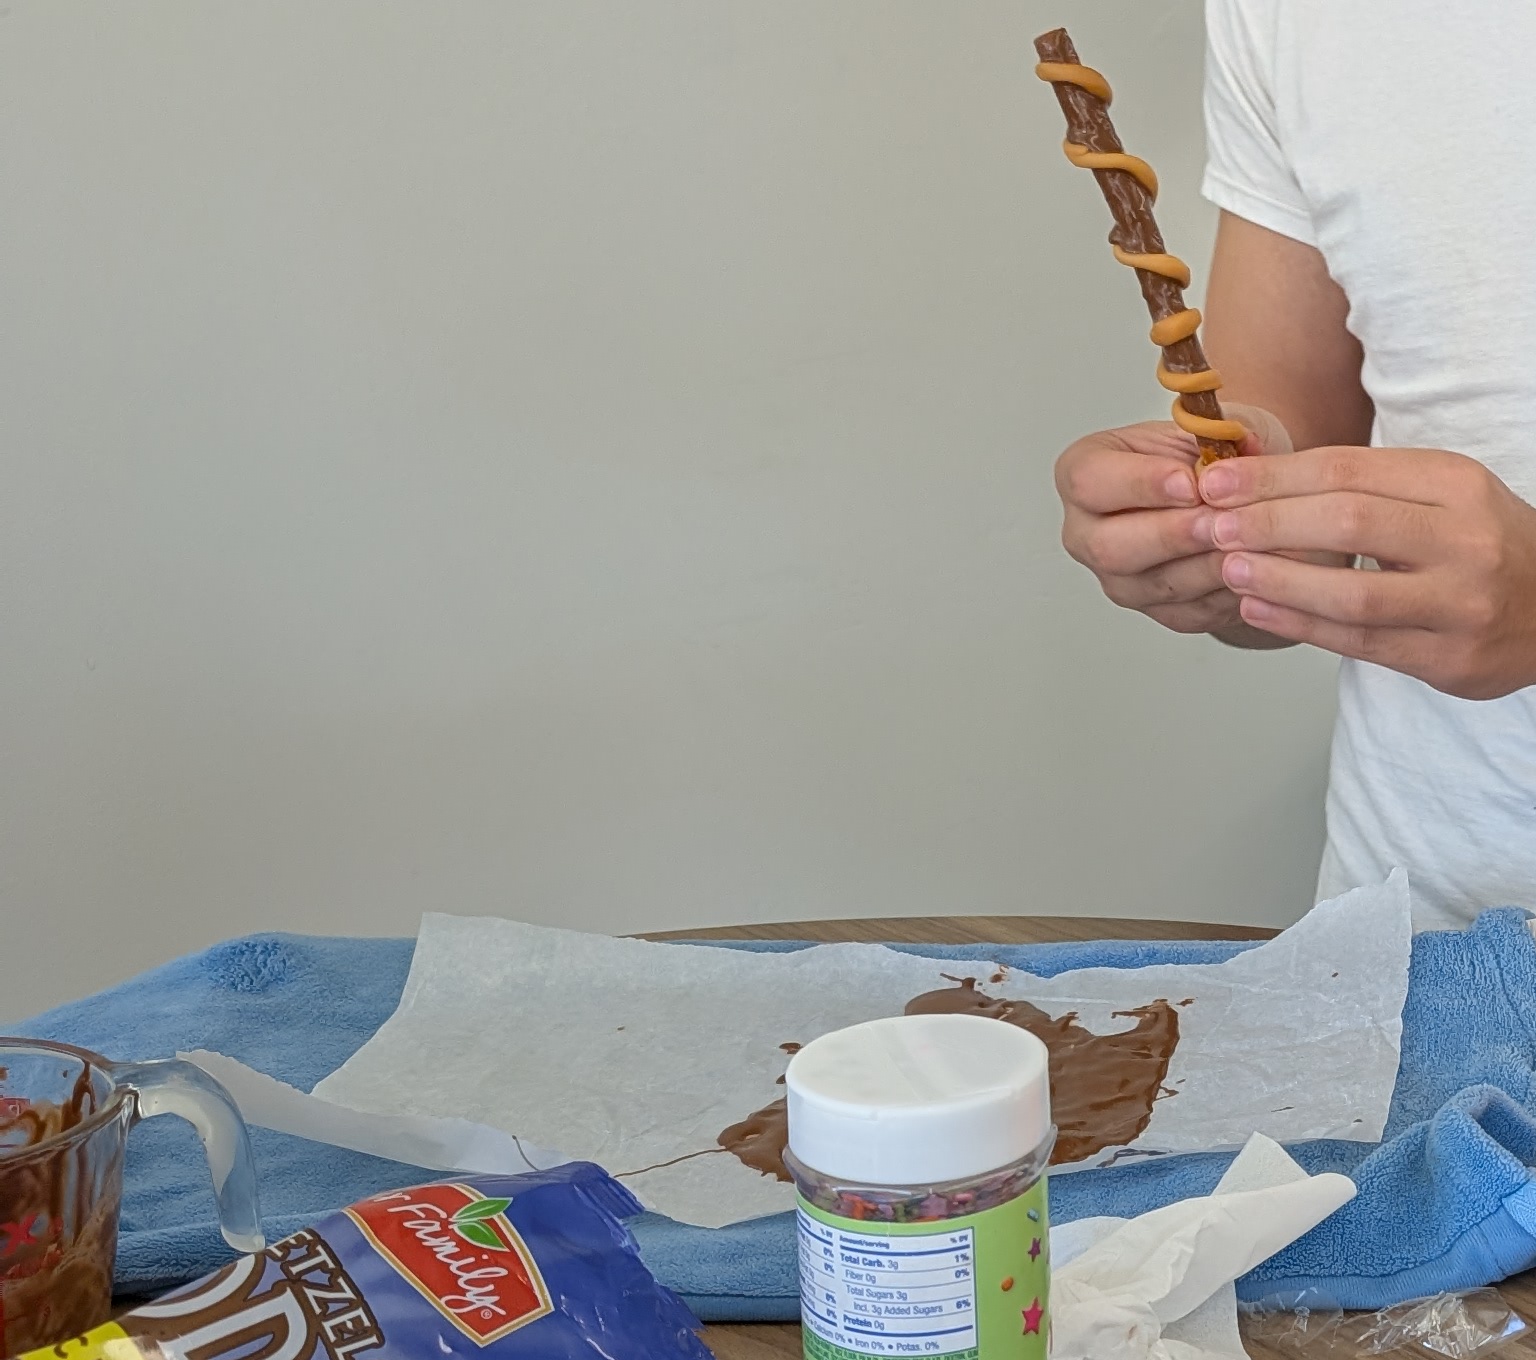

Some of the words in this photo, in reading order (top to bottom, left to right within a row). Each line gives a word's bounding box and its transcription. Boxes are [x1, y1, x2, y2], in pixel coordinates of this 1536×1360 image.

[387, 1203, 508, 1315] Family
[840, 1253, 860, 1265] Total
[862, 1257, 885, 1268] Carb.
[888, 1259, 899, 1270] 3g
[955, 1253, 970, 1263] 1%
[846, 1269, 864, 1282] Fiber
[866, 1273, 876, 1284] 0g
[955, 1269, 970, 1278] 0%
[846, 1284, 864, 1297] Total
[866, 1288, 894, 1301] Sugars
[896, 1290, 908, 1300] 3g
[854, 1302, 869, 1312] Incl.
[872, 1304, 882, 1315] 3g
[884, 1306, 911, 1315] Added
[913, 1304, 943, 1316] Sugars
[843, 1314, 872, 1328] Protein
[874, 1320, 885, 1330] 0g
[855, 1338, 870, 1349] Iron
[871, 1340, 885, 1350] 0%
[896, 1343, 922, 1352] Potas.
[924, 1341, 940, 1350] 0%
